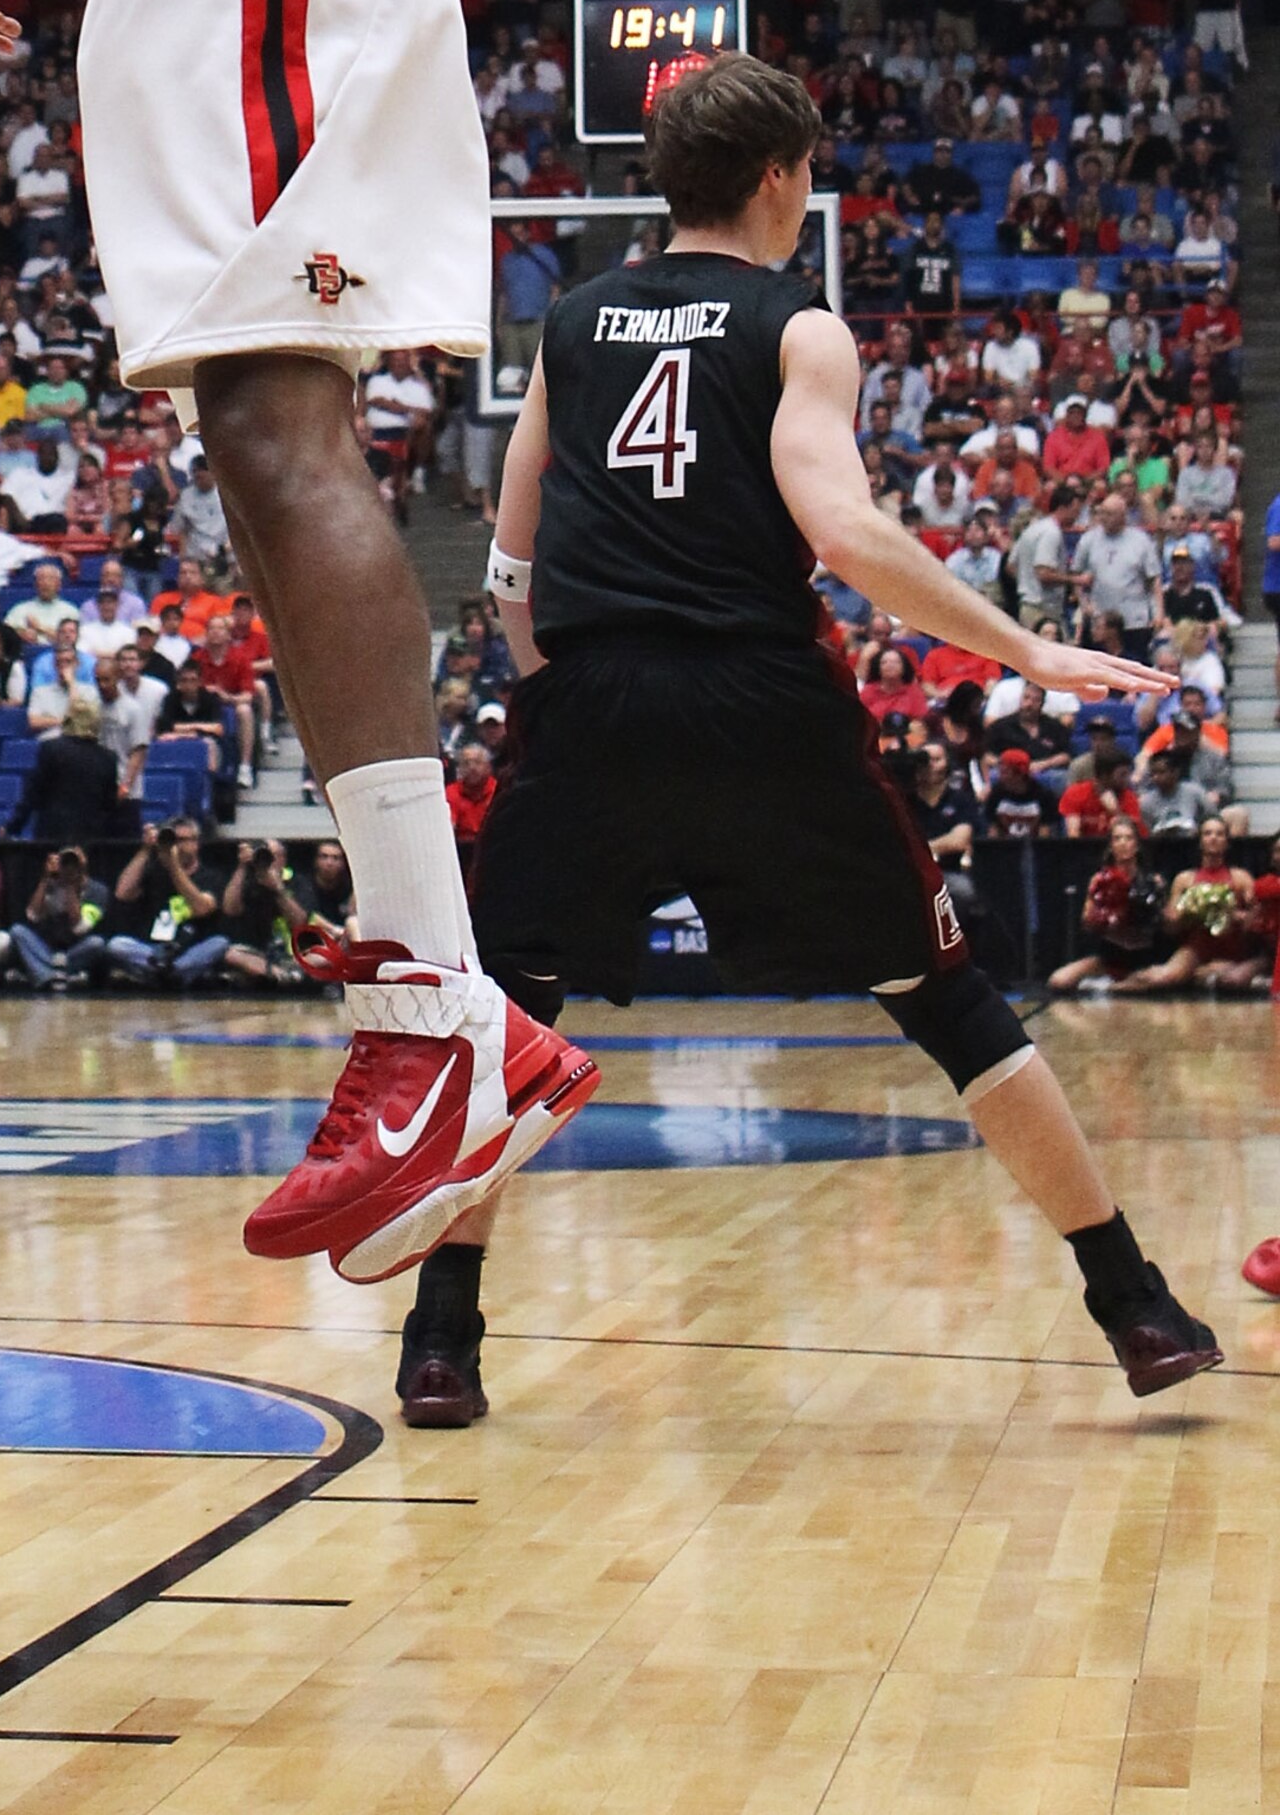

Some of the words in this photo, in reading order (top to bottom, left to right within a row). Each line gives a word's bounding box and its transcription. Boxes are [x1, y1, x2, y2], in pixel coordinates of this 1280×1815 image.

[610, 5, 725, 49] 19:41
[594, 302, 731, 343] FERNANDEZ
[607, 347, 697, 500] 4
